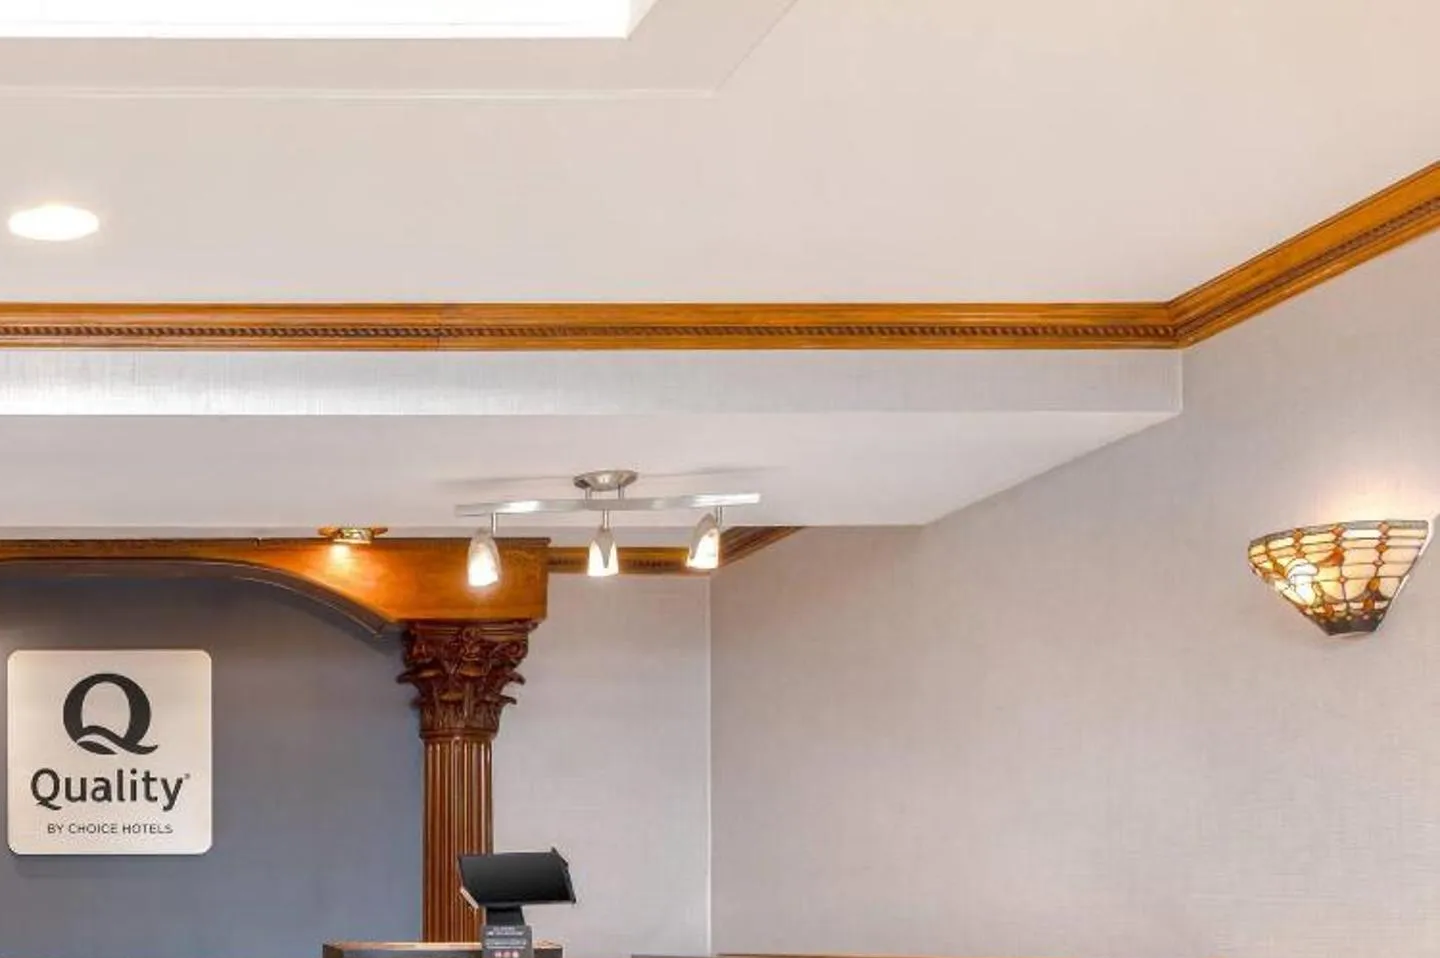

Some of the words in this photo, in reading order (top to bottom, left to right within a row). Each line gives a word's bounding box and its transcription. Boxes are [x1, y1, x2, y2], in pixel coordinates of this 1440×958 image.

[62, 672, 159, 755] Q
[30, 767, 184, 812] Quality
[47, 823, 64, 834] BY
[68, 823, 118, 834] CHOICE
[122, 823, 173, 834] HOTELS
